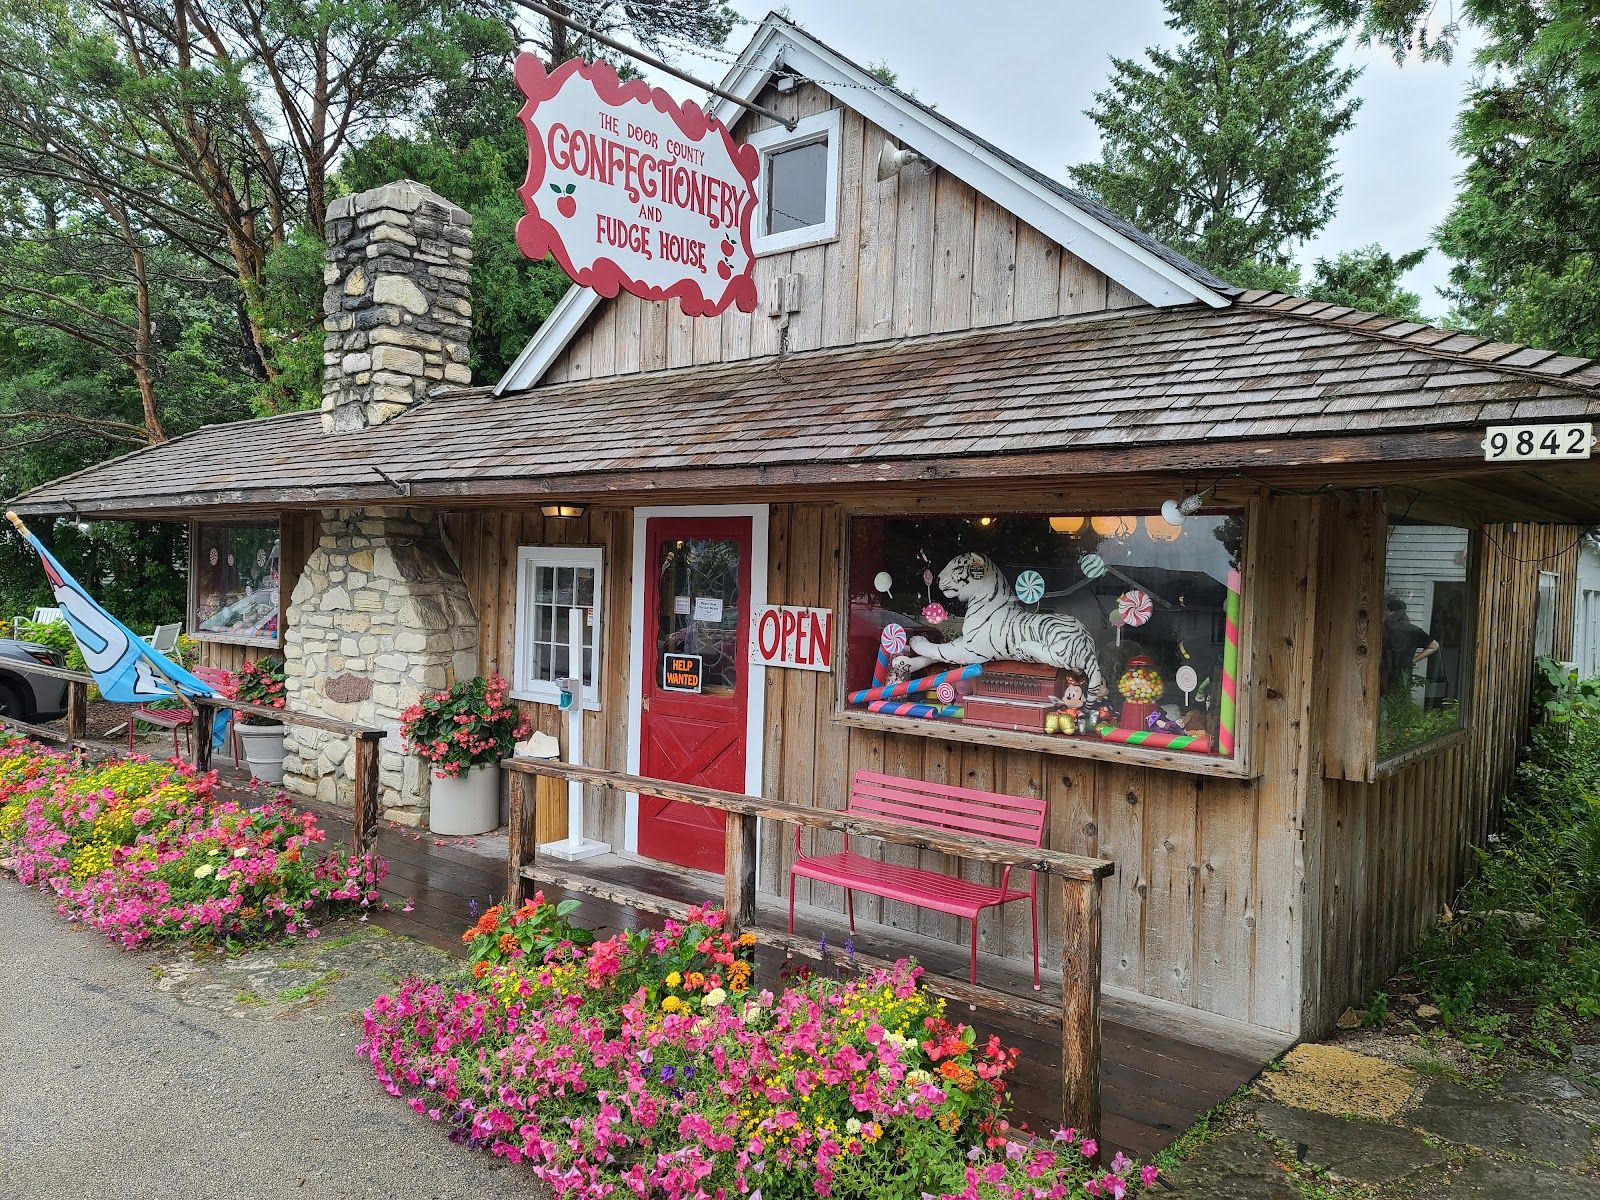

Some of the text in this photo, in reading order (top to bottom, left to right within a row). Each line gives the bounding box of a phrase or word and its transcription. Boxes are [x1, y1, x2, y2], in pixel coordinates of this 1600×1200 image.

[599, 112, 705, 166] THE DOOR COUNTY
[548, 123, 746, 229] CONFECTIONERY
[638, 204, 662, 222] AND
[596, 214, 707, 274] FUDGE HOUSE
[1491, 429, 1585, 457] 9842
[759, 610, 831, 666] OPEN
[667, 672, 698, 686] WANTED
[673, 659, 693, 671] HELP
